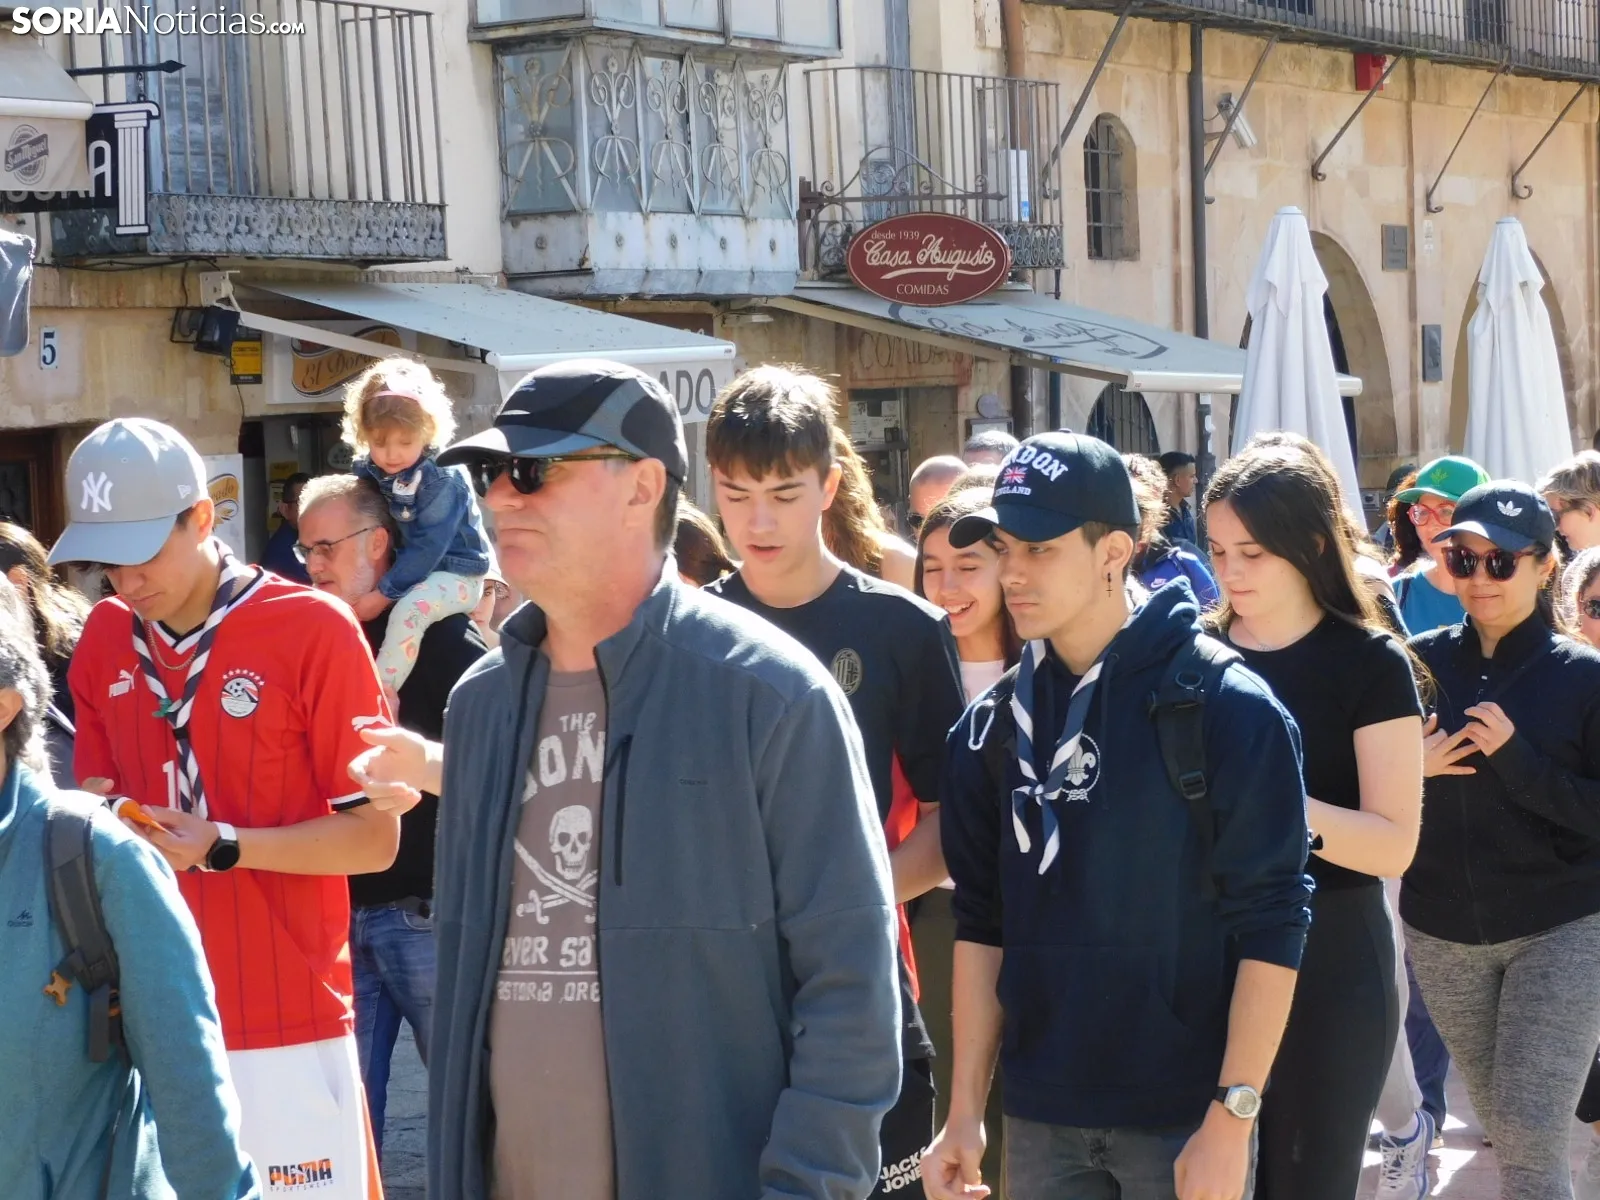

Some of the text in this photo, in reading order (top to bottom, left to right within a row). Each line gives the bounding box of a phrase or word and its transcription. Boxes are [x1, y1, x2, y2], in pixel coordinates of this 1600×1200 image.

[871, 230, 920, 240] desde 1939
[917, 234, 995, 281] Augusto
[896, 283, 949, 295] COMIDAS
[42, 331, 56, 366] 5
[521, 731, 605, 800] ON
[268, 1158, 332, 1186] PUMA
[880, 1151, 921, 1180] JACK
